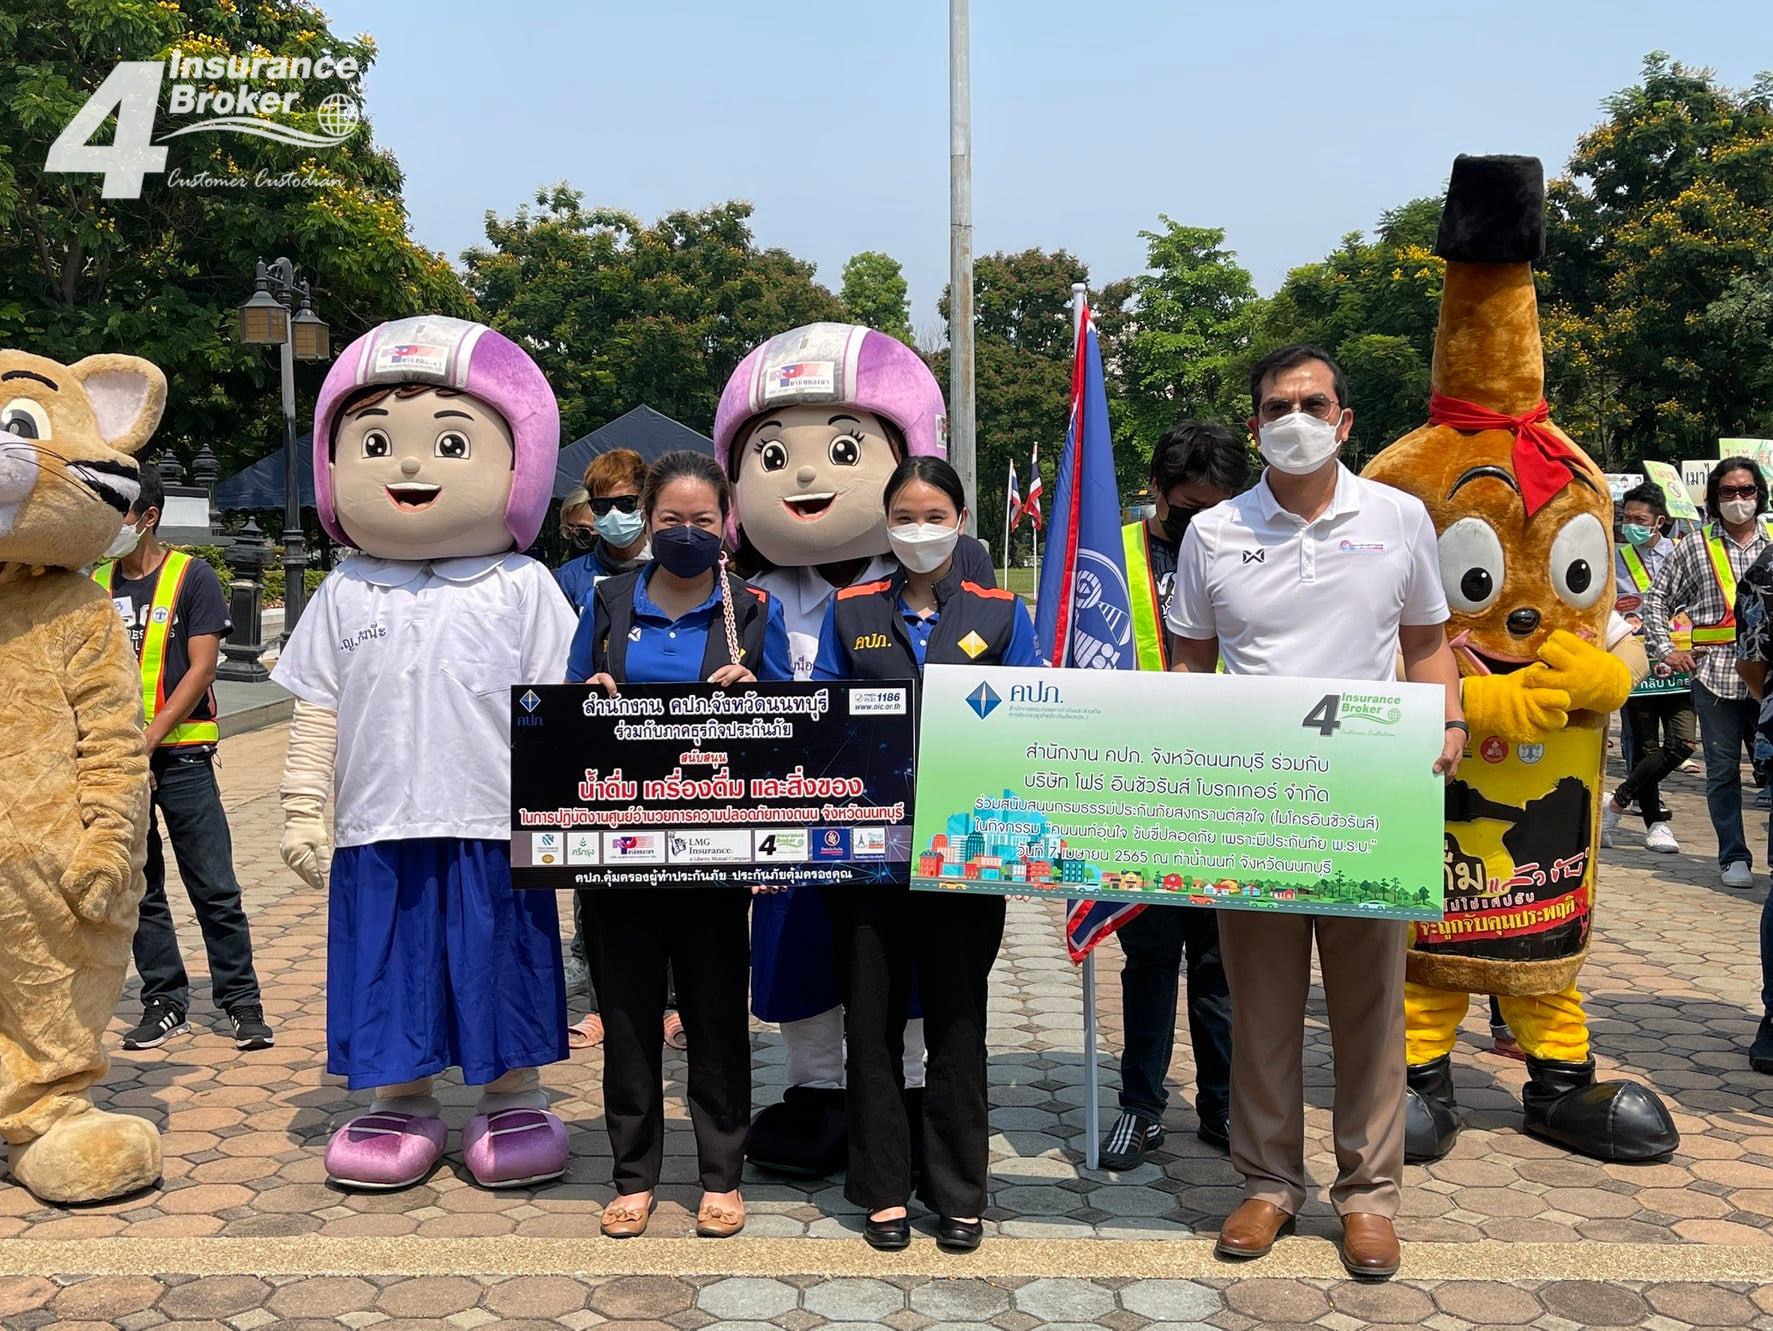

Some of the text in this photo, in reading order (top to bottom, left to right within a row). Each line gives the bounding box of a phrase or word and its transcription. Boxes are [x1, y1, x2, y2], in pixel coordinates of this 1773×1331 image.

[853, 632, 892, 651] คปภ.
[877, 692, 901, 702] 1186
[1010, 681, 1064, 704] คปภ.
[1342, 692, 1401, 704] Insurance
[583, 688, 829, 721] สำนักงาน คปภ.จังหวัดนนทบุรี
[855, 703, 901, 711] www.oic.or.th
[1302, 694, 1341, 737] 4
[1342, 703, 1383, 713] Broker
[614, 716, 793, 746] ร่วมกับภาคธุรกิจประกันภัย
[680, 750, 727, 769] สนับสนุน
[1026, 741, 1329, 773] สำนักงาน คปภ. จังหวัดนนทบุรี ร่วมกับ
[578, 766, 863, 800] น้ำดื่ม เครื่องดื่ม และสิ่งของ
[1024, 772, 1329, 803] บริษัท โฟร์ อินชัวรันส์ โบรกเกอร์ จำกัด
[821, 801, 904, 825] จังหวัดนนทบุรี
[975, 794, 1380, 832] ร่วมสนับสนุนกรมธรรม์ประกันภัยสงกรานต์สุขใจ (ไมโครอินชัวรันส์)
[688, 838, 711, 846] LMG
[758, 834, 777, 856] 4
[974, 818, 1041, 835] ในกิจกรรม
[1133, 826, 1216, 844] ขับขี่ปลอดภัย
[1221, 831, 1327, 850] เพราะมีประกันภัย
[1017, 839, 1332, 877] วันที่ 7 เมษายน 2565 ณ ท่าน้ำนนท์ จังหวัดนนทบุรี
[575, 867, 852, 887] คปภ.คุ้มครองผู้ทำประกันภัย ประกันภัยคุ้มครองคุณ
